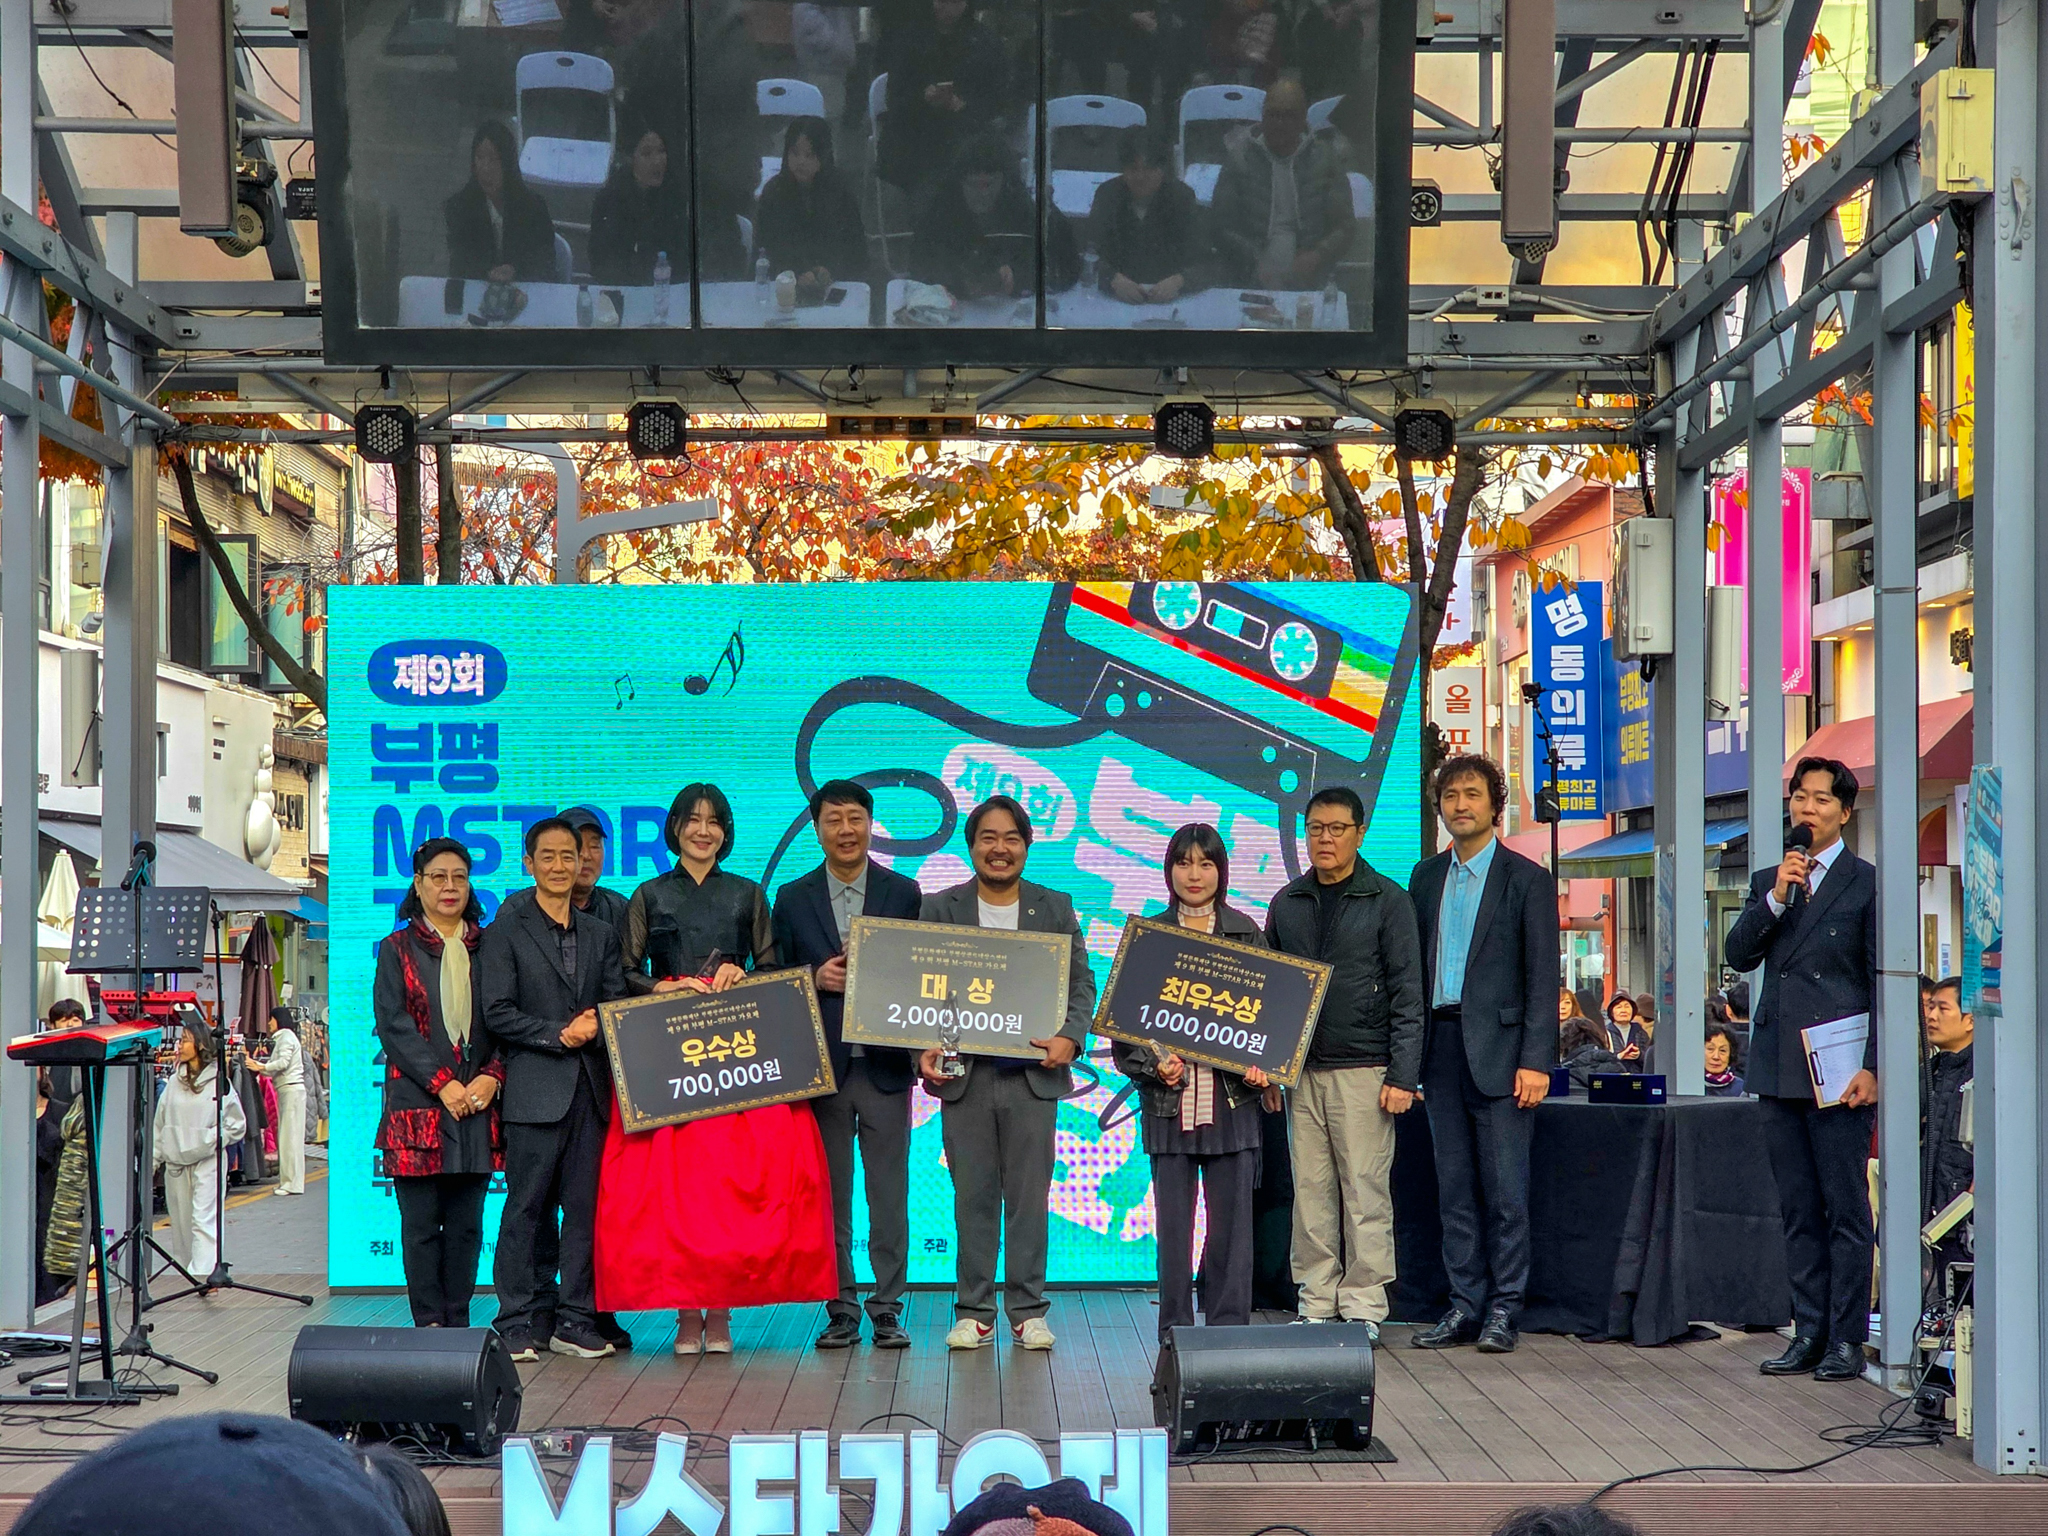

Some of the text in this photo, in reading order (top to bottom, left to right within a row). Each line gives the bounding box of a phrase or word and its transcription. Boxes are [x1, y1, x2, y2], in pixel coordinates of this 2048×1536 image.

[392, 651, 485, 697] 제9회
[370, 722, 500, 794] 부평
[952, 959, 983, 969] M-STAR
[1211, 970, 1242, 984] M-STAR
[920, 973, 995, 1005] 대 상
[1159, 976, 1262, 1024] 최우수상
[706, 1014, 738, 1027] M-STAR
[887, 1003, 1023, 1035] 2,000,000원
[1139, 1004, 1268, 1056] 1,000,000원
[680, 1028, 758, 1068] 우수상
[668, 1058, 782, 1100] 700,000원
[369, 1240, 394, 1256] 주최
[923, 1238, 948, 1253] 주관
